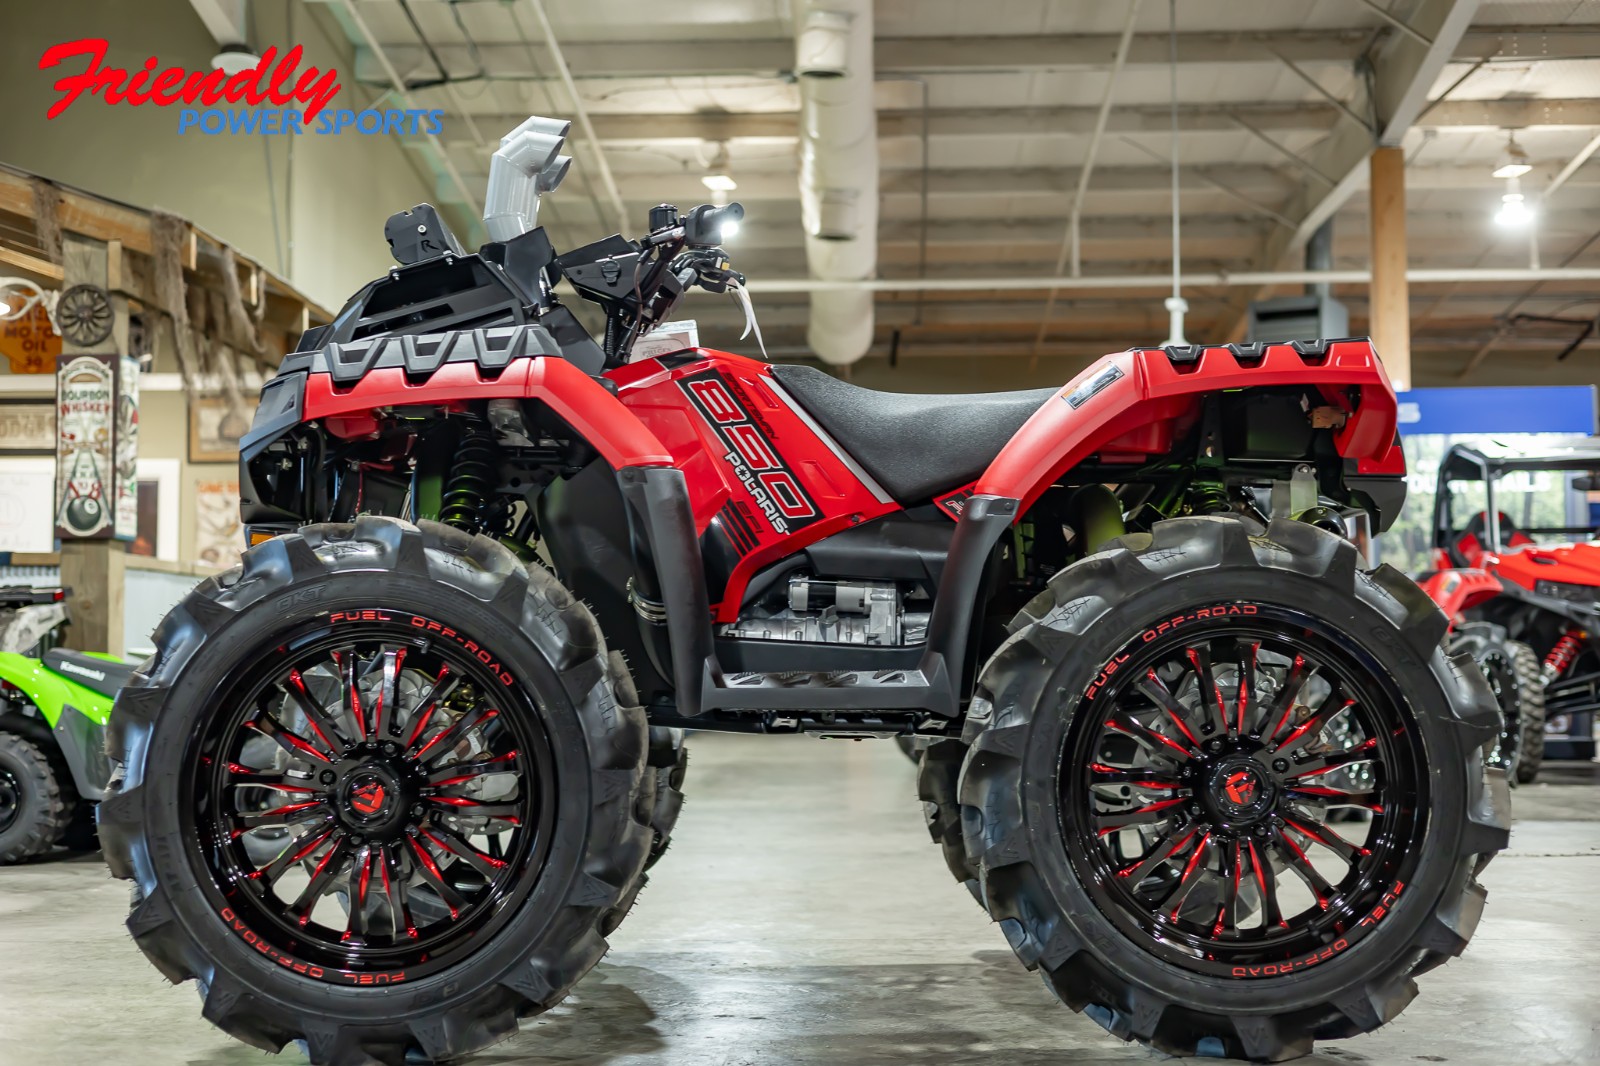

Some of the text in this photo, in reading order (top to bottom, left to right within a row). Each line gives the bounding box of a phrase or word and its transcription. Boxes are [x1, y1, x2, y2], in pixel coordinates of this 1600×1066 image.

[22, 339, 48, 352] OIL
[60, 402, 110, 416] WHISKEY
[61, 390, 110, 400] BOURBON
[722, 372, 780, 441] SPORTSMAN
[687, 378, 816, 519] 850
[724, 451, 791, 536] POLARIS
[735, 500, 765, 534] EFI
[330, 609, 514, 686] FUEL OFF-ROAD
[1086, 605, 1258, 700] FUEL OFF-ROAD
[220, 906, 406, 985] FUEL OFF-ROAD
[1231, 879, 1405, 977] FUEL OFF-ROAD
